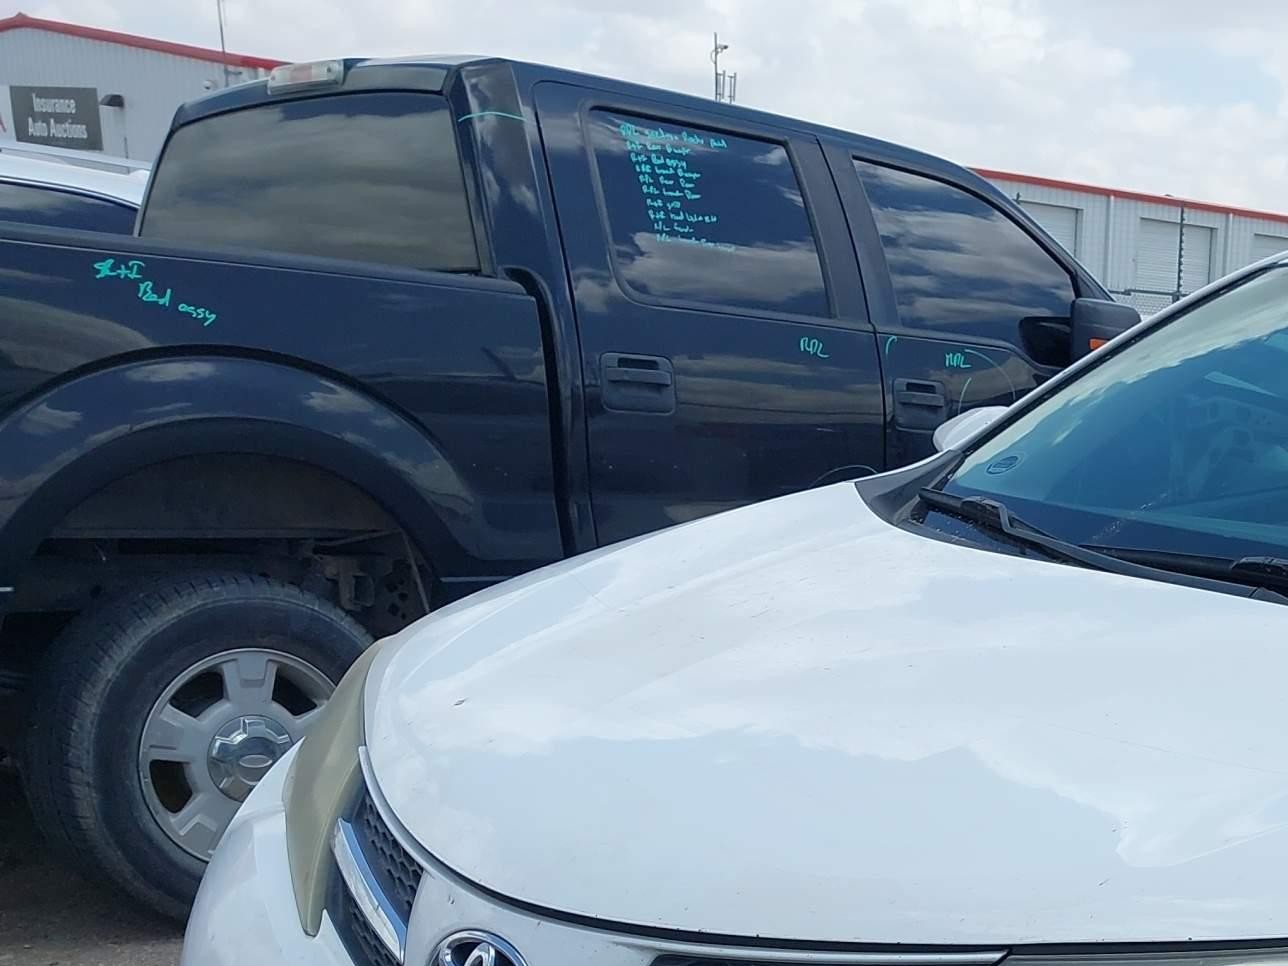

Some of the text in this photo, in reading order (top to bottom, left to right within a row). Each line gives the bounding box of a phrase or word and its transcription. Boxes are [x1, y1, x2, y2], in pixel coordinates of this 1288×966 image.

[32, 93, 76, 114] Insurance
[28, 117, 48, 136] Auto
[50, 118, 88, 138] Auctions
